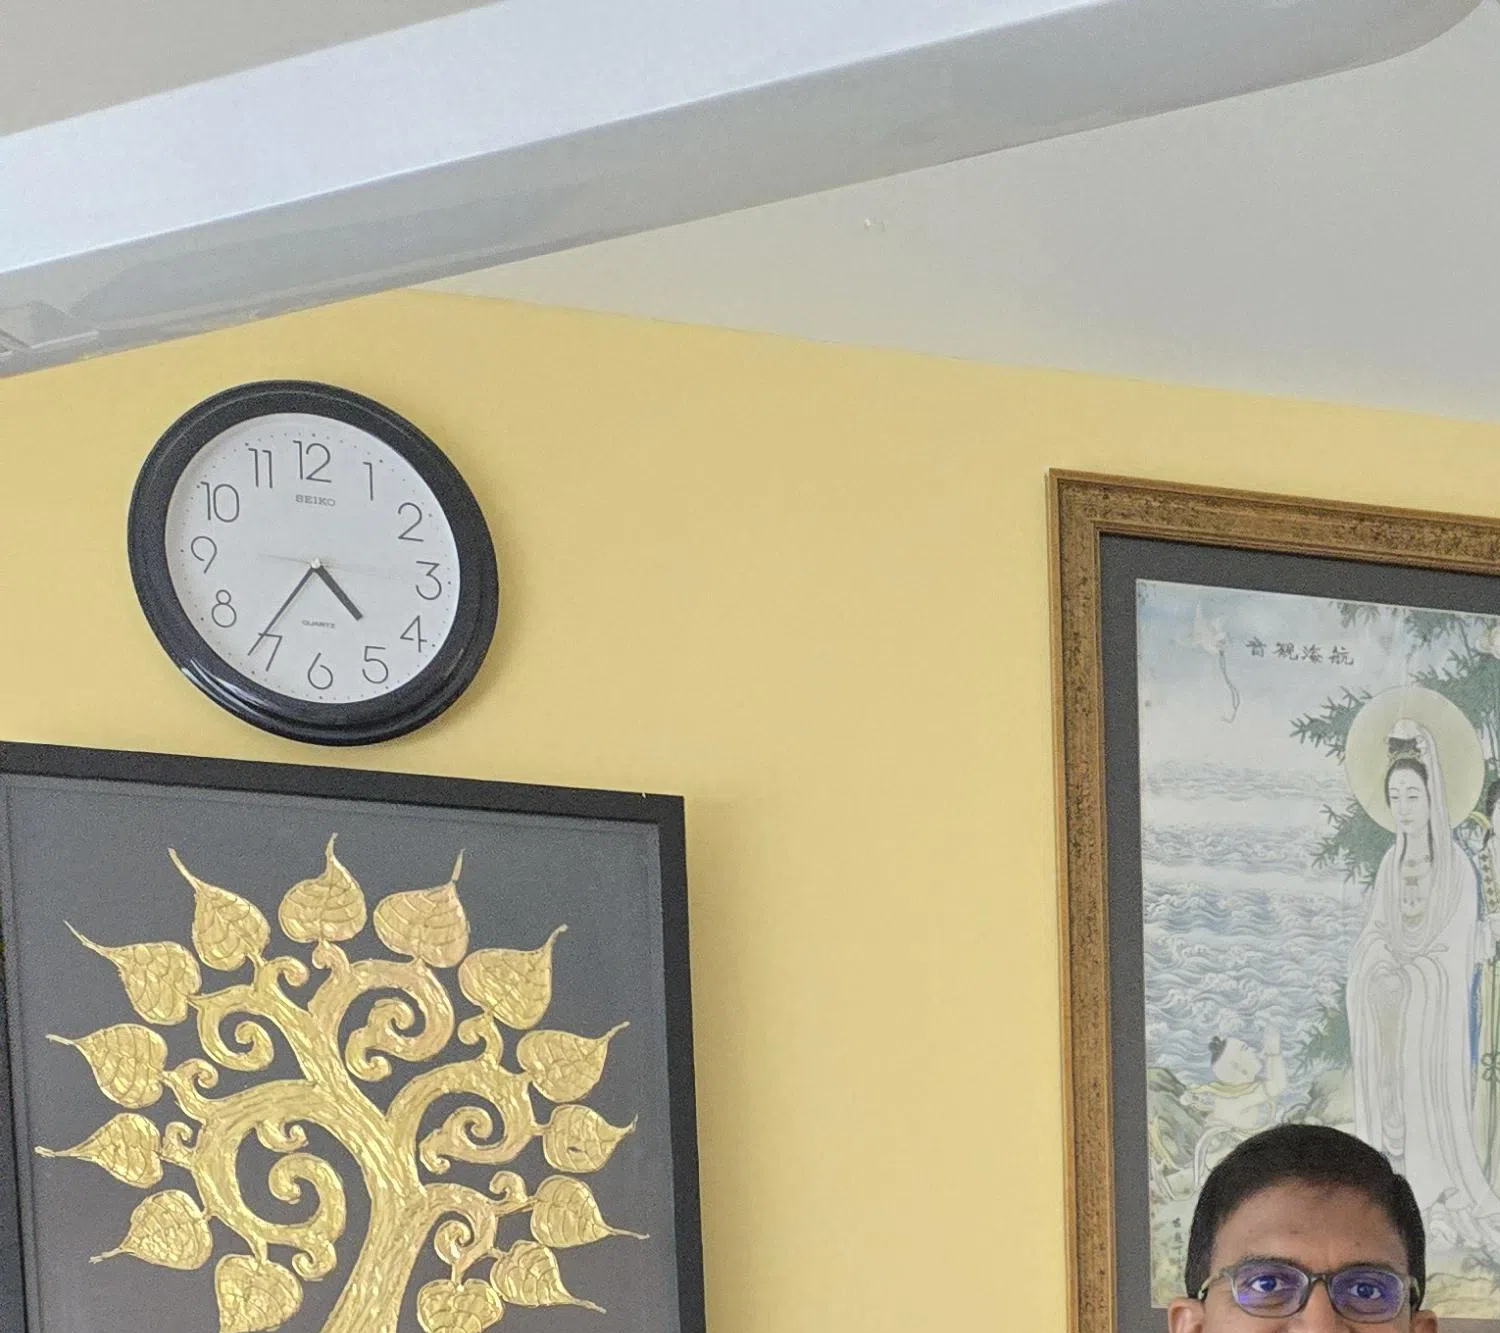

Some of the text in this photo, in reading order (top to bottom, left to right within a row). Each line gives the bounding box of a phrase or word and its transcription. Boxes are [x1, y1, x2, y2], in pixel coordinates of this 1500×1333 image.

[248, 447, 273, 489] 11
[293, 439, 332, 483] 12
[295, 494, 336, 507] SEIKO
[363, 461, 375, 501] 1
[200, 481, 240, 523] 10
[397, 502, 424, 542] 2
[190, 536, 217, 574] 9
[415, 561, 442, 601] 3
[211, 589, 237, 628] 8
[258, 633, 283, 672] 7
[400, 615, 427, 653] 4
[307, 652, 333, 690] 6
[362, 646, 389, 684] 5
